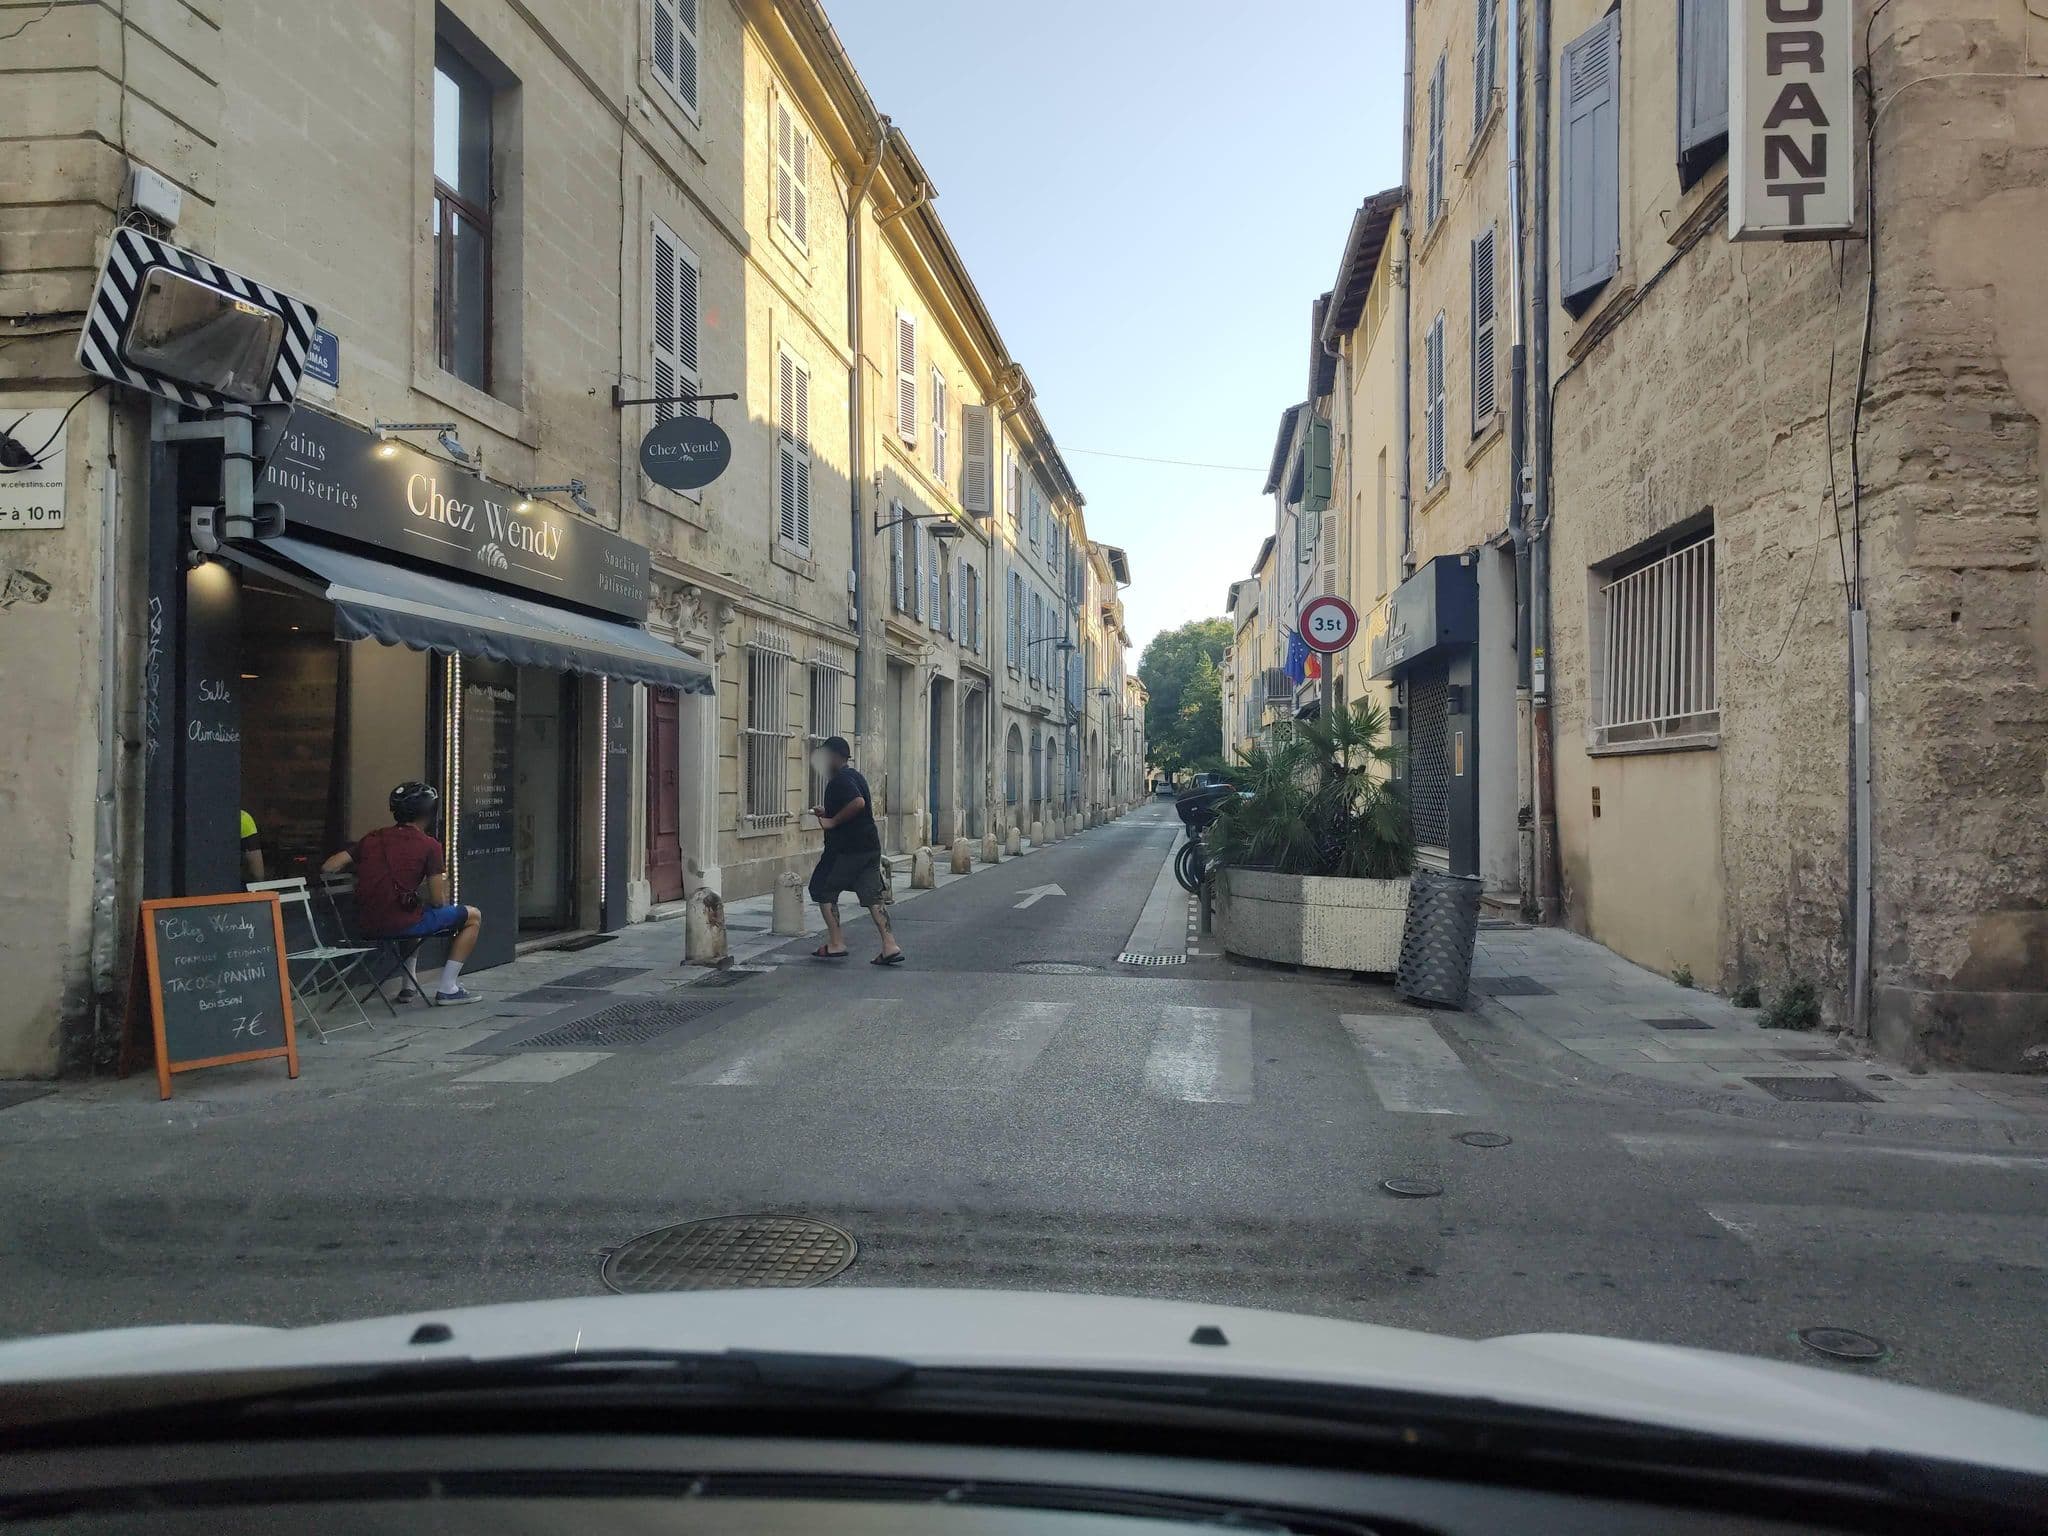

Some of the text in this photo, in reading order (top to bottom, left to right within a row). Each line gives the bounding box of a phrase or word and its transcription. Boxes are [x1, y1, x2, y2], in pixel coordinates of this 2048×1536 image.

[308, 351, 329, 369] IMAS
[649, 443, 677, 456] Chez
[406, 473, 475, 534] Chez
[11, 506, 61, 521] à 10 m
[198, 679, 231, 704] Salle
